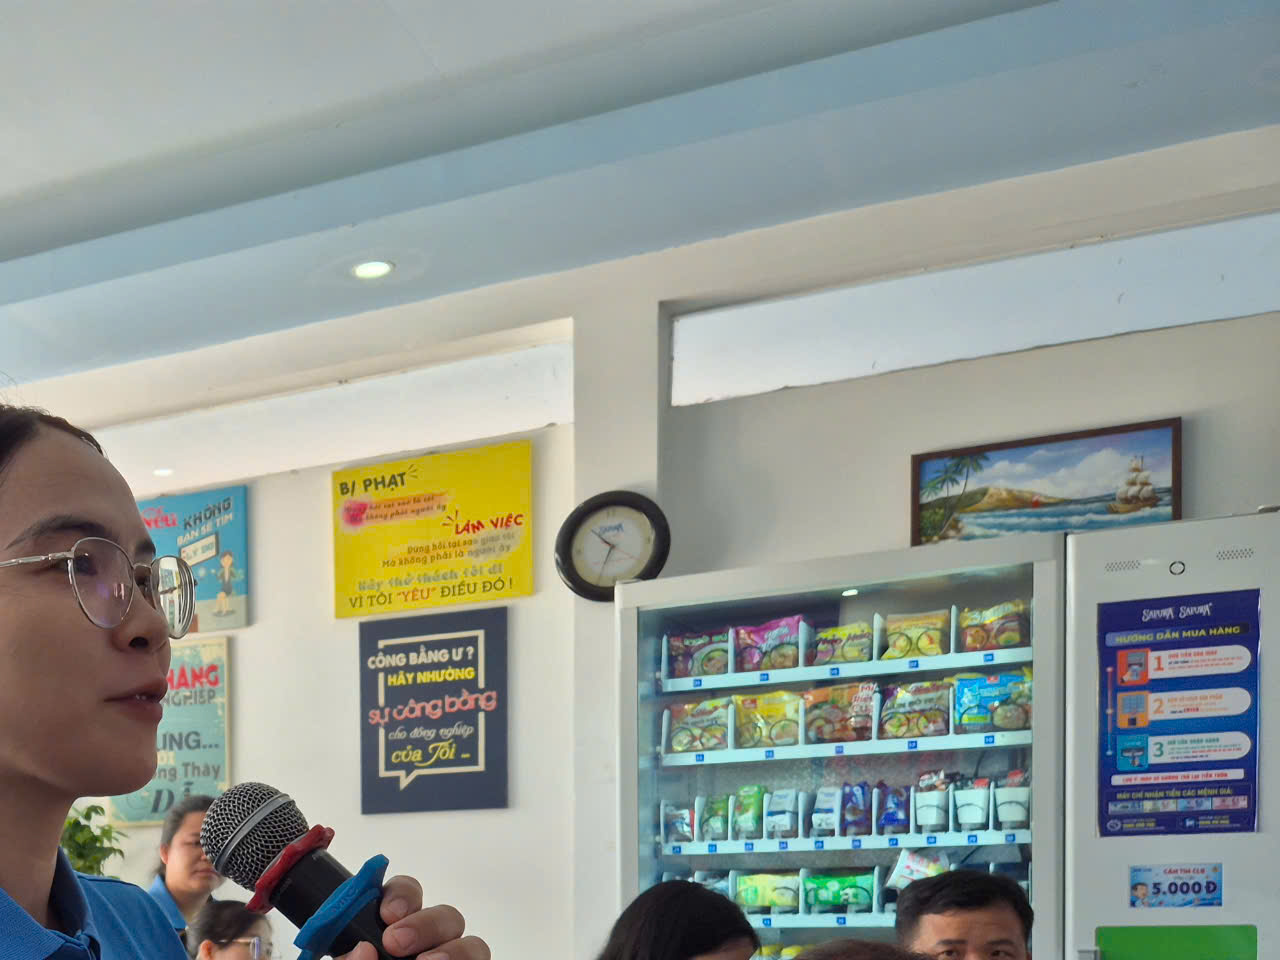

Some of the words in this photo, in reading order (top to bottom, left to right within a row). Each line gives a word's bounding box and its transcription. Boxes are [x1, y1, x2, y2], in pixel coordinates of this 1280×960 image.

[363, 472, 407, 491] PHẠT
[366, 590, 393, 608] TÔI
[481, 576, 506, 593] ĐÓ
[1182, 627, 1207, 638] MUA
[368, 651, 407, 669] CÔNG
[409, 645, 450, 664] BẰNG
[1153, 655, 1165, 672] 1
[387, 669, 416, 686] HÃY
[1152, 697, 1165, 715] 2
[1152, 741, 1164, 758] 3
[1152, 881, 1202, 896] 5.000
